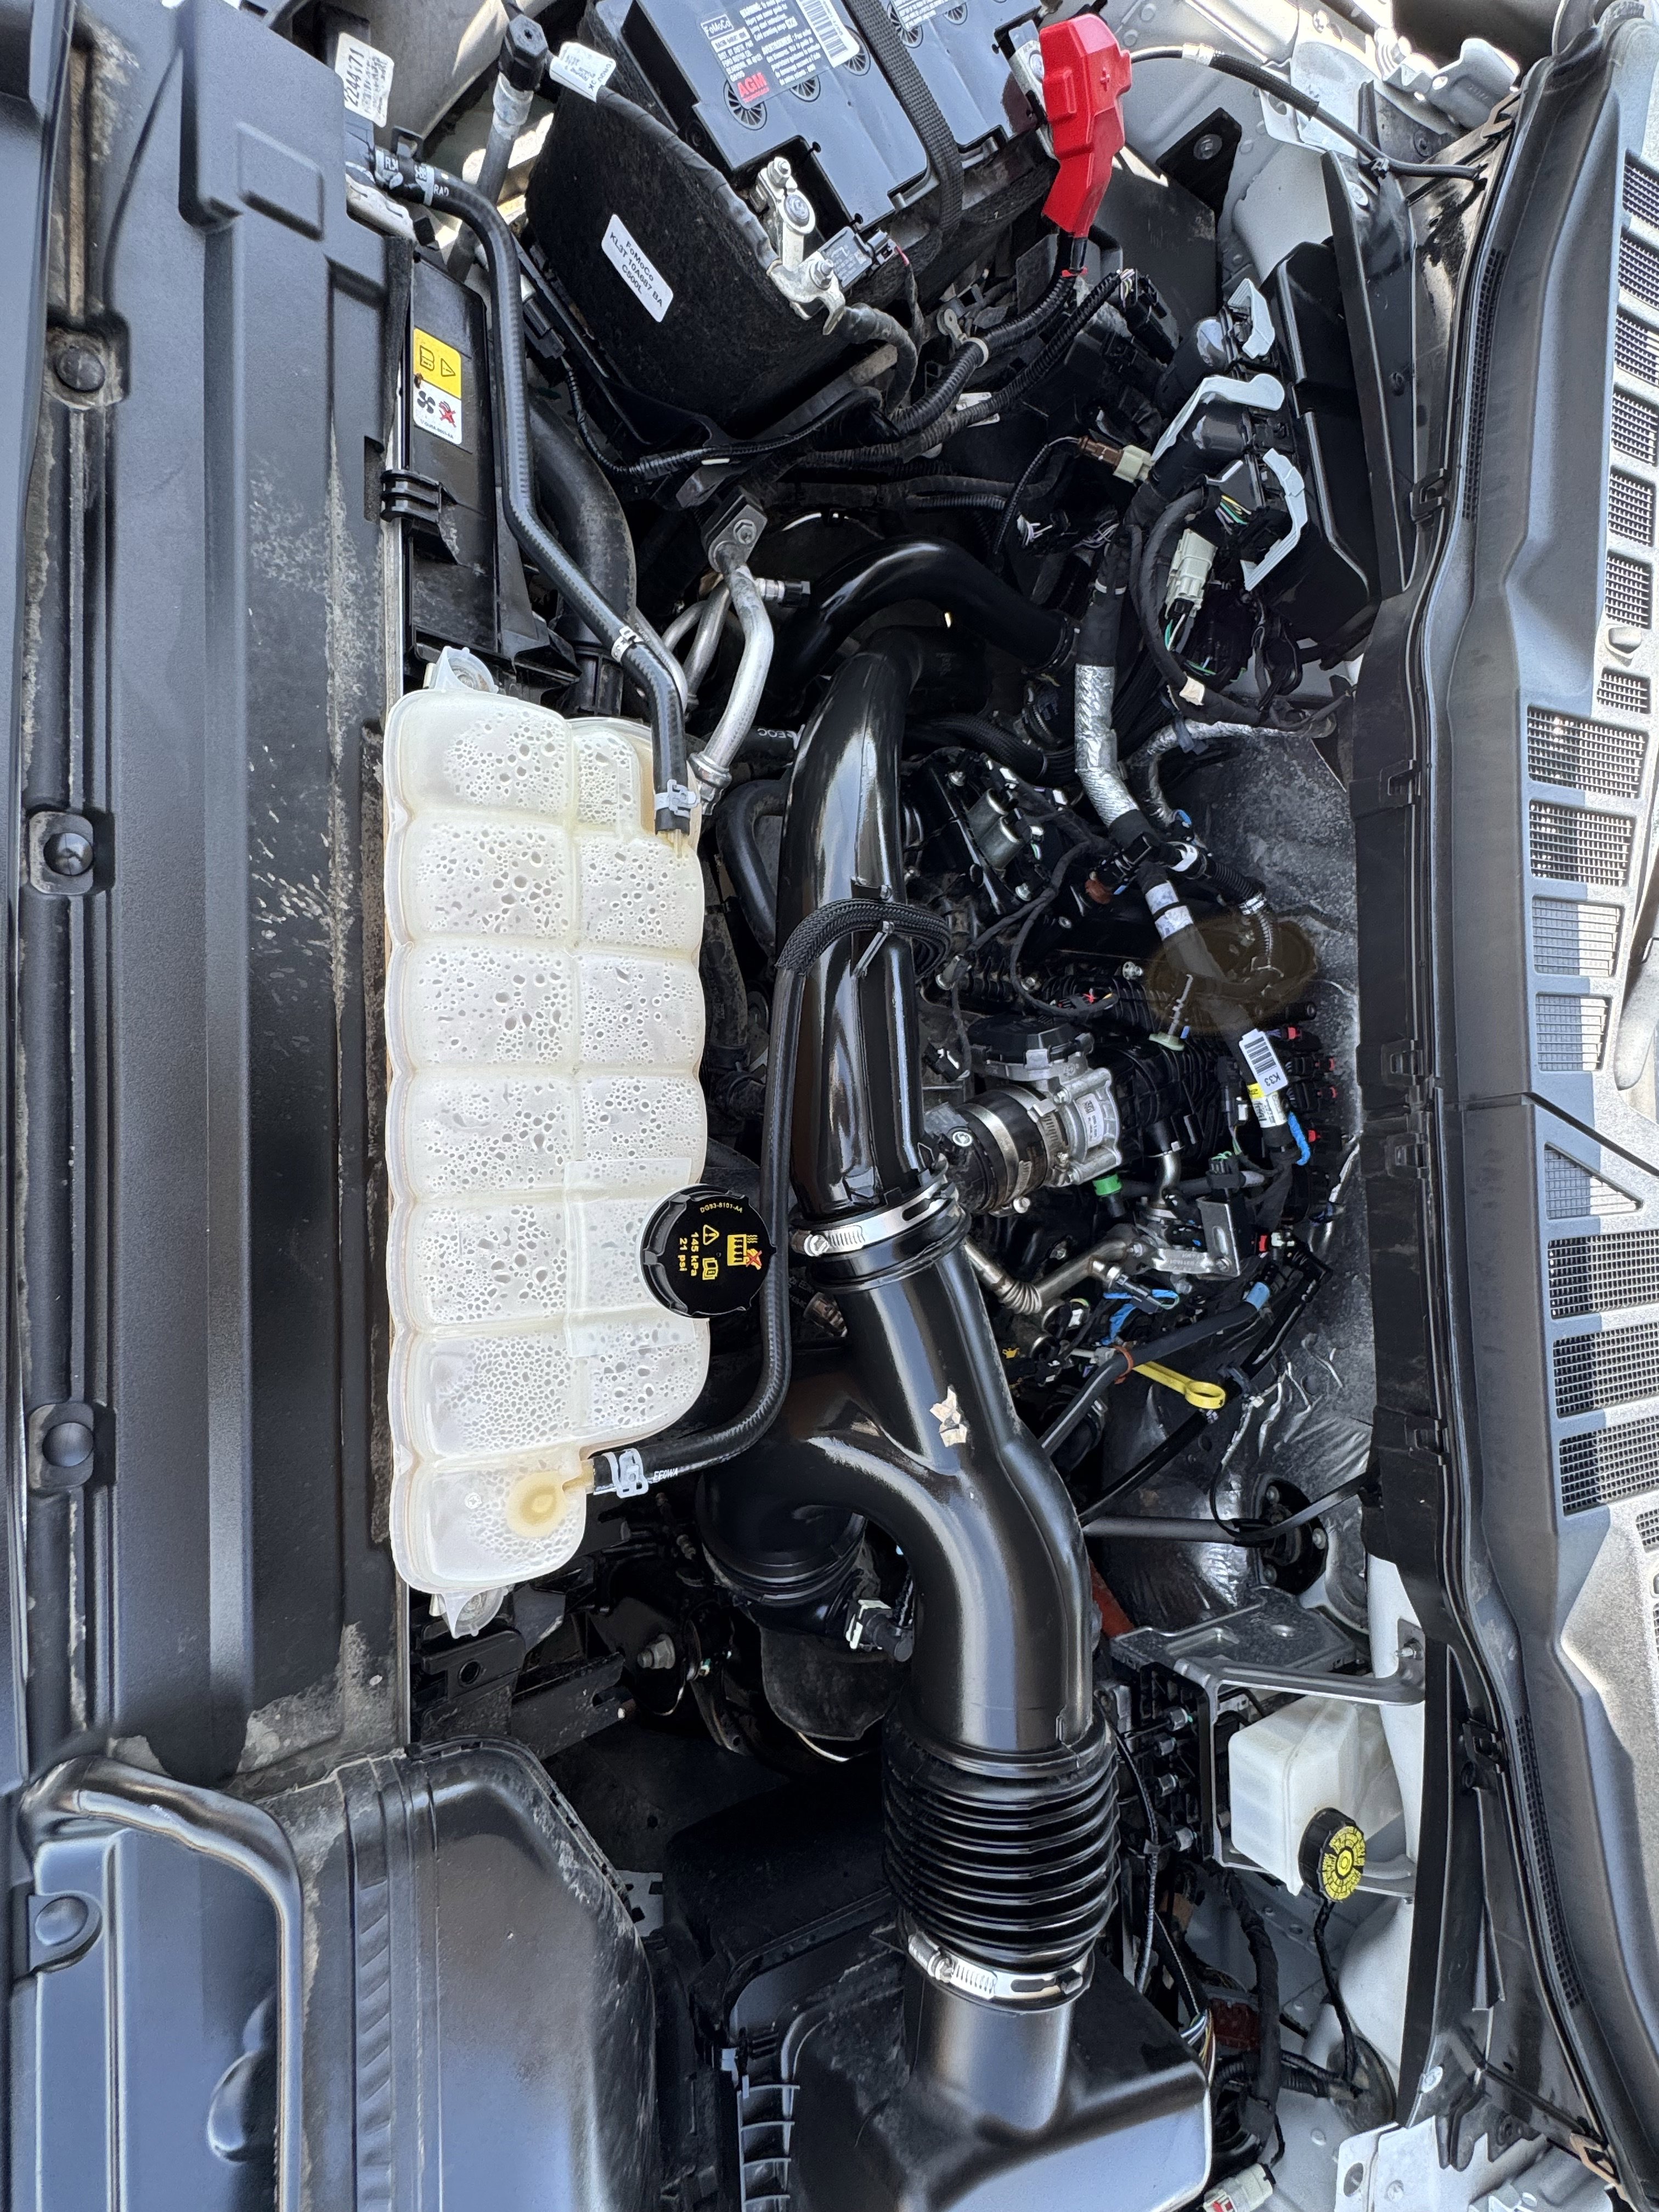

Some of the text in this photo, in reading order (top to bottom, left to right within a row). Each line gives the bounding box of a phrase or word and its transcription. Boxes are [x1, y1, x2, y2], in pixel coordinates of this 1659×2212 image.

[737, 72, 767, 98] AGM
[610, 232, 628, 258] KL3T
[626, 241, 653, 281] FoMoCo
[1264, 1072, 1281, 1087] K33
[678, 1237, 688, 1272] 21 psi
[691, 1232, 699, 1277] 145 kPa
